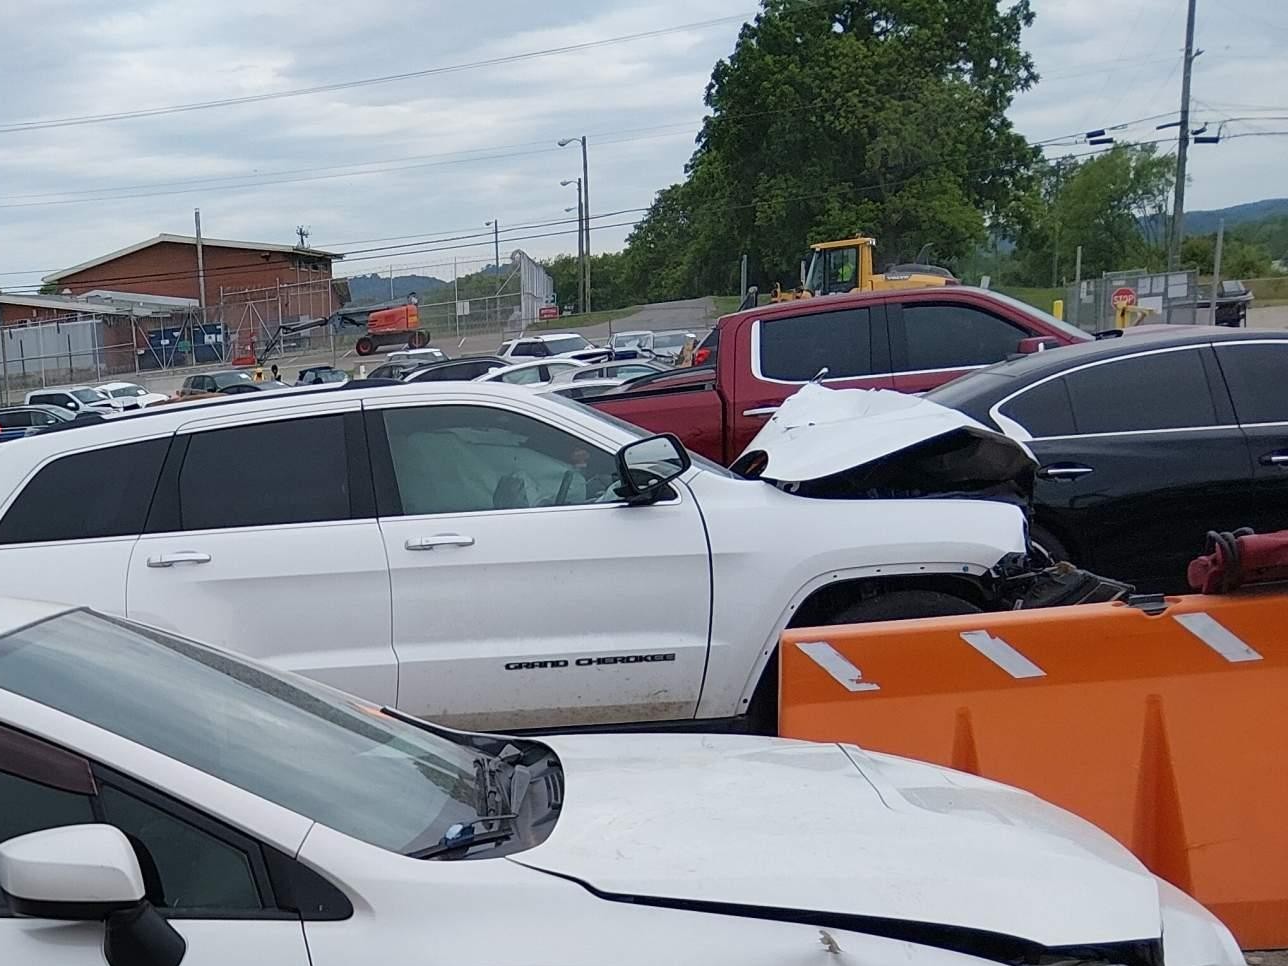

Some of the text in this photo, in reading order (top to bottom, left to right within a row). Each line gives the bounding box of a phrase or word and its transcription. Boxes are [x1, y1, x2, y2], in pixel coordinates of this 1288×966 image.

[1113, 295, 1134, 305] STOP
[505, 653, 676, 671] GRAND CHEROKEE
